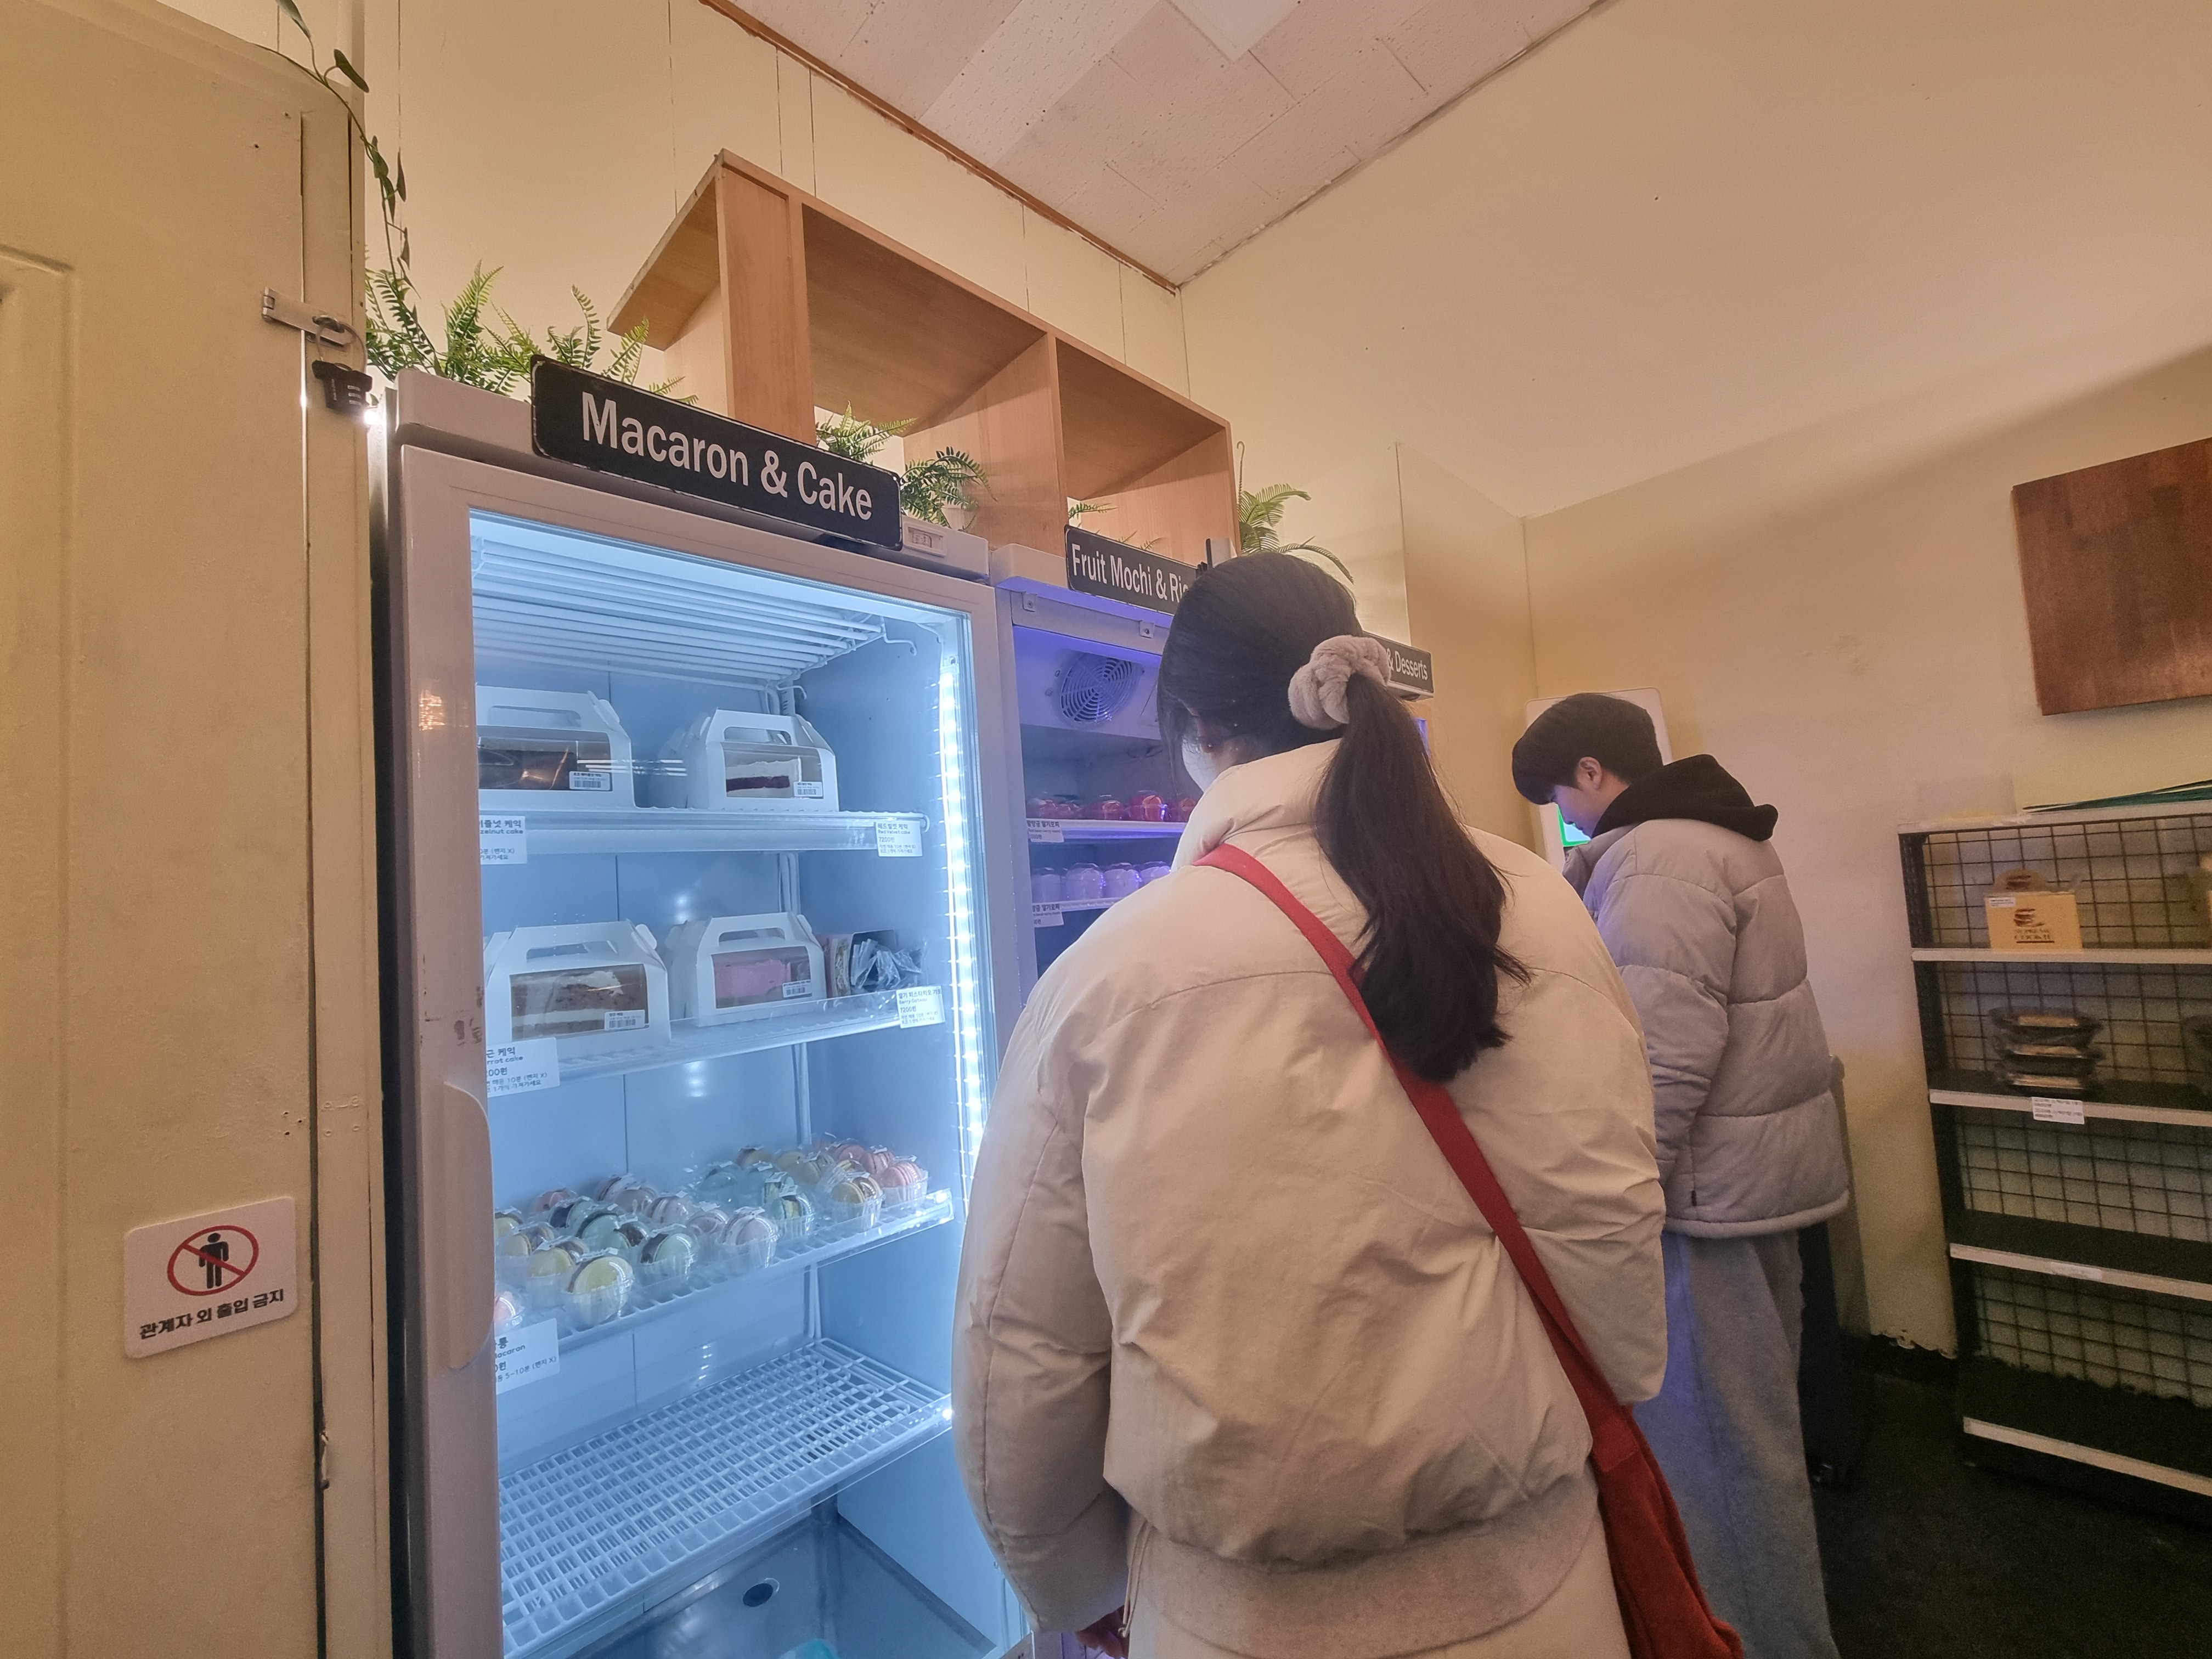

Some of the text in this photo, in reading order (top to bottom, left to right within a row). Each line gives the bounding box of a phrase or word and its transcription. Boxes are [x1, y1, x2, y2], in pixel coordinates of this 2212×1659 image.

[582, 391, 873, 521] Macaron & Cake
[1072, 544, 1107, 584] Fruit
[1110, 555, 1152, 596] Mochi
[1156, 568, 1167, 600] &
[1387, 648, 1428, 680] & Desserts
[504, 820, 521, 828] 케익
[487, 1046, 515, 1058] 근 케익
[488, 1067, 507, 1076] 00원
[140, 1288, 284, 1340] 관계자 외 출입 금지
[495, 1345, 526, 1359] acaron
